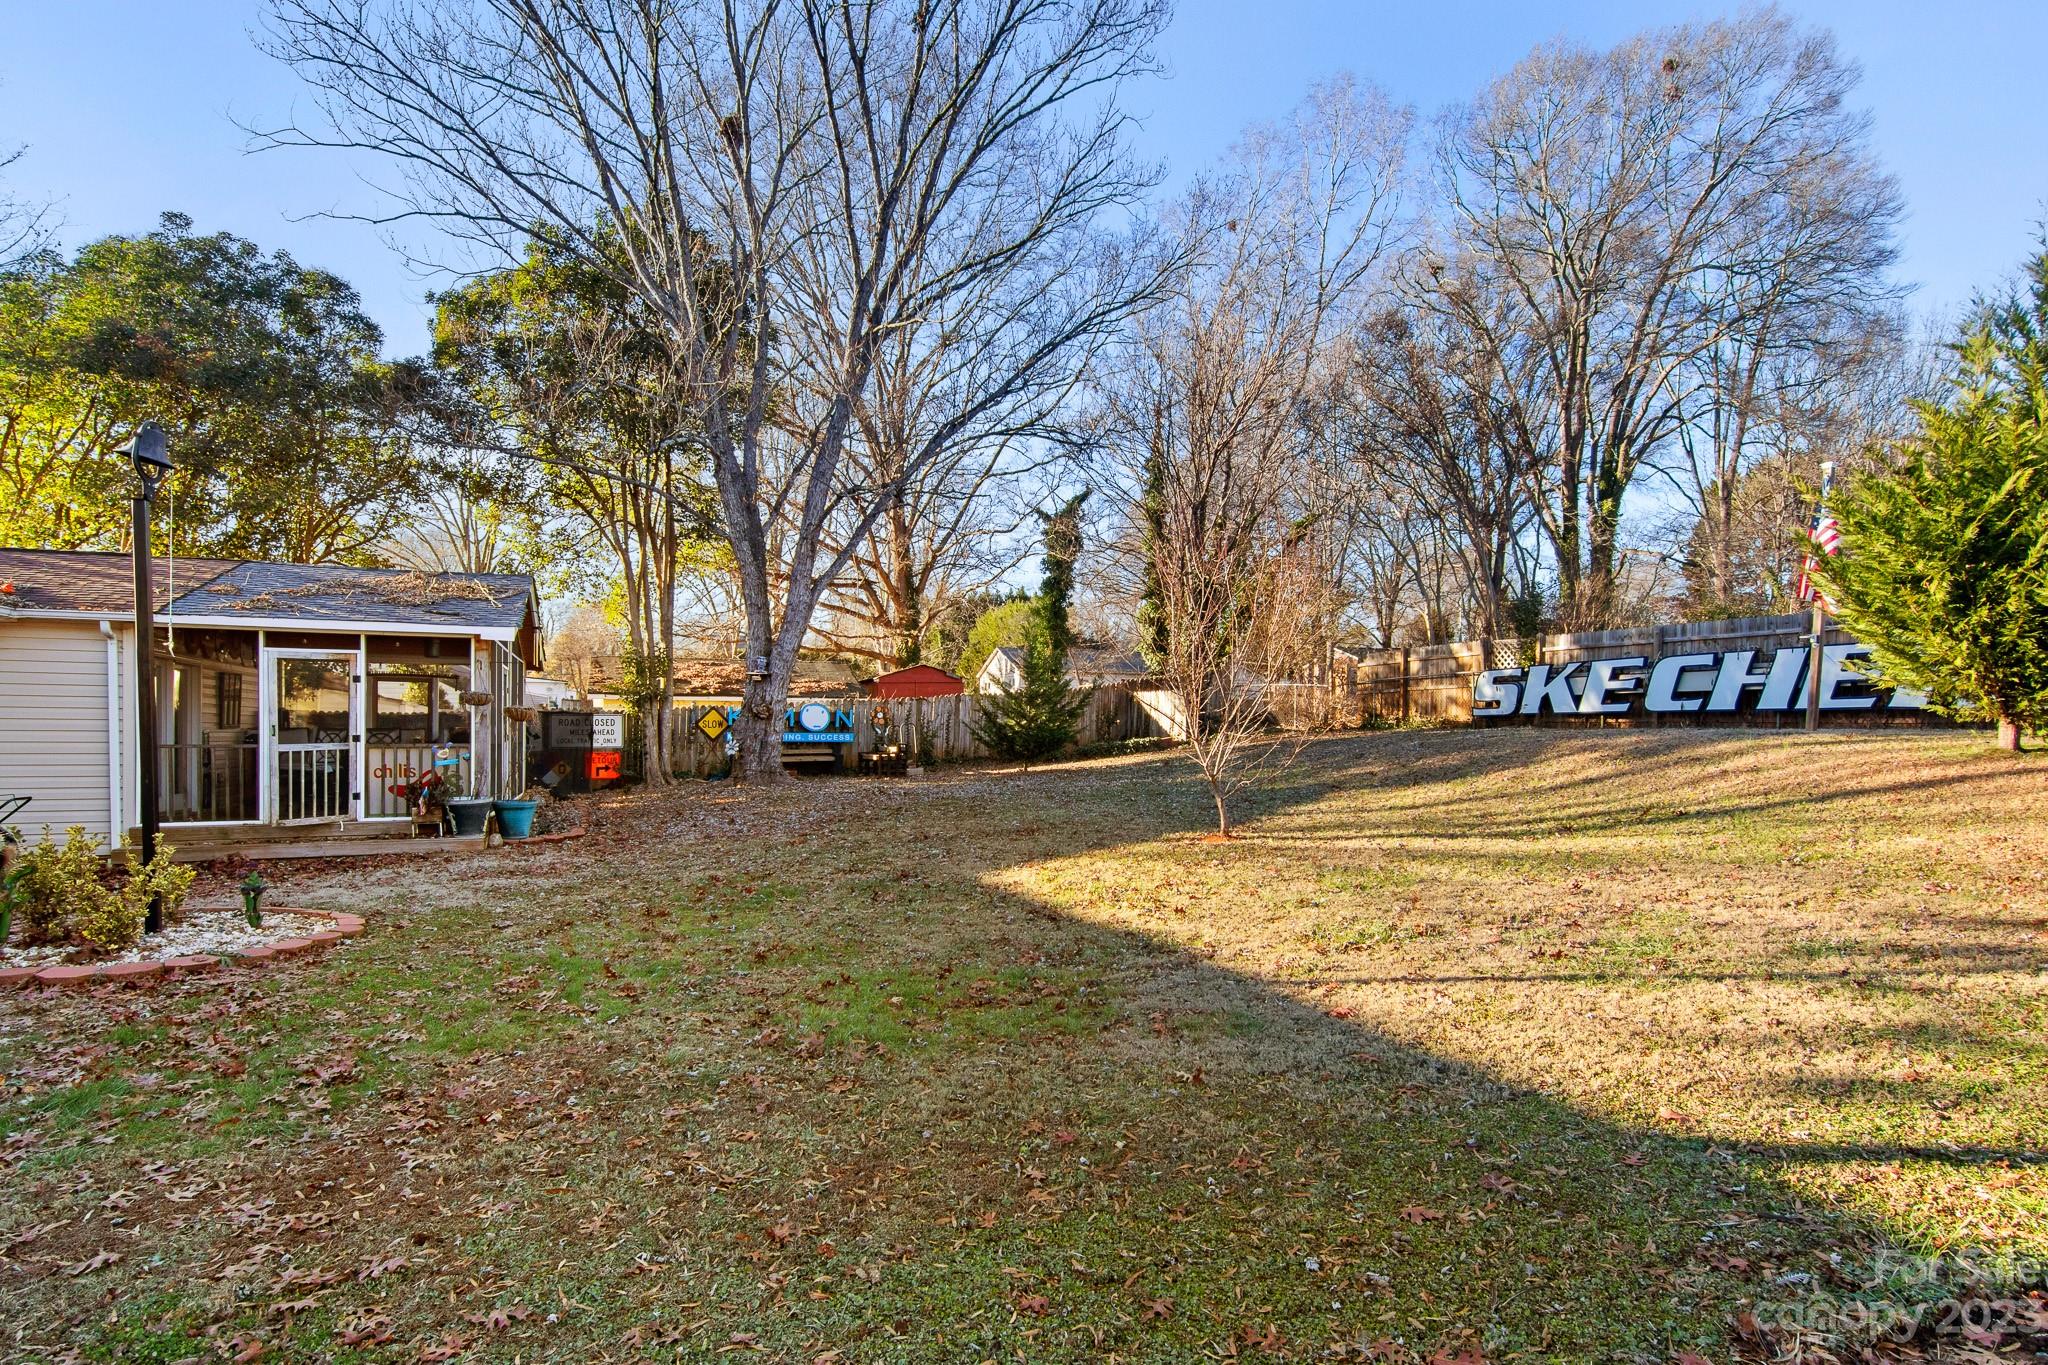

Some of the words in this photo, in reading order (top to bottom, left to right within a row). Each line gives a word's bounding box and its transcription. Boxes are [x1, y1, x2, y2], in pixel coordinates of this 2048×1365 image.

[1473, 643, 1977, 717] SKECHE
[558, 718, 580, 727] ROAD
[584, 718, 616, 727] CLOSED
[702, 719, 723, 729] SLOW
[592, 728, 615, 736] AHEAD
[373, 763, 417, 778] chlis
